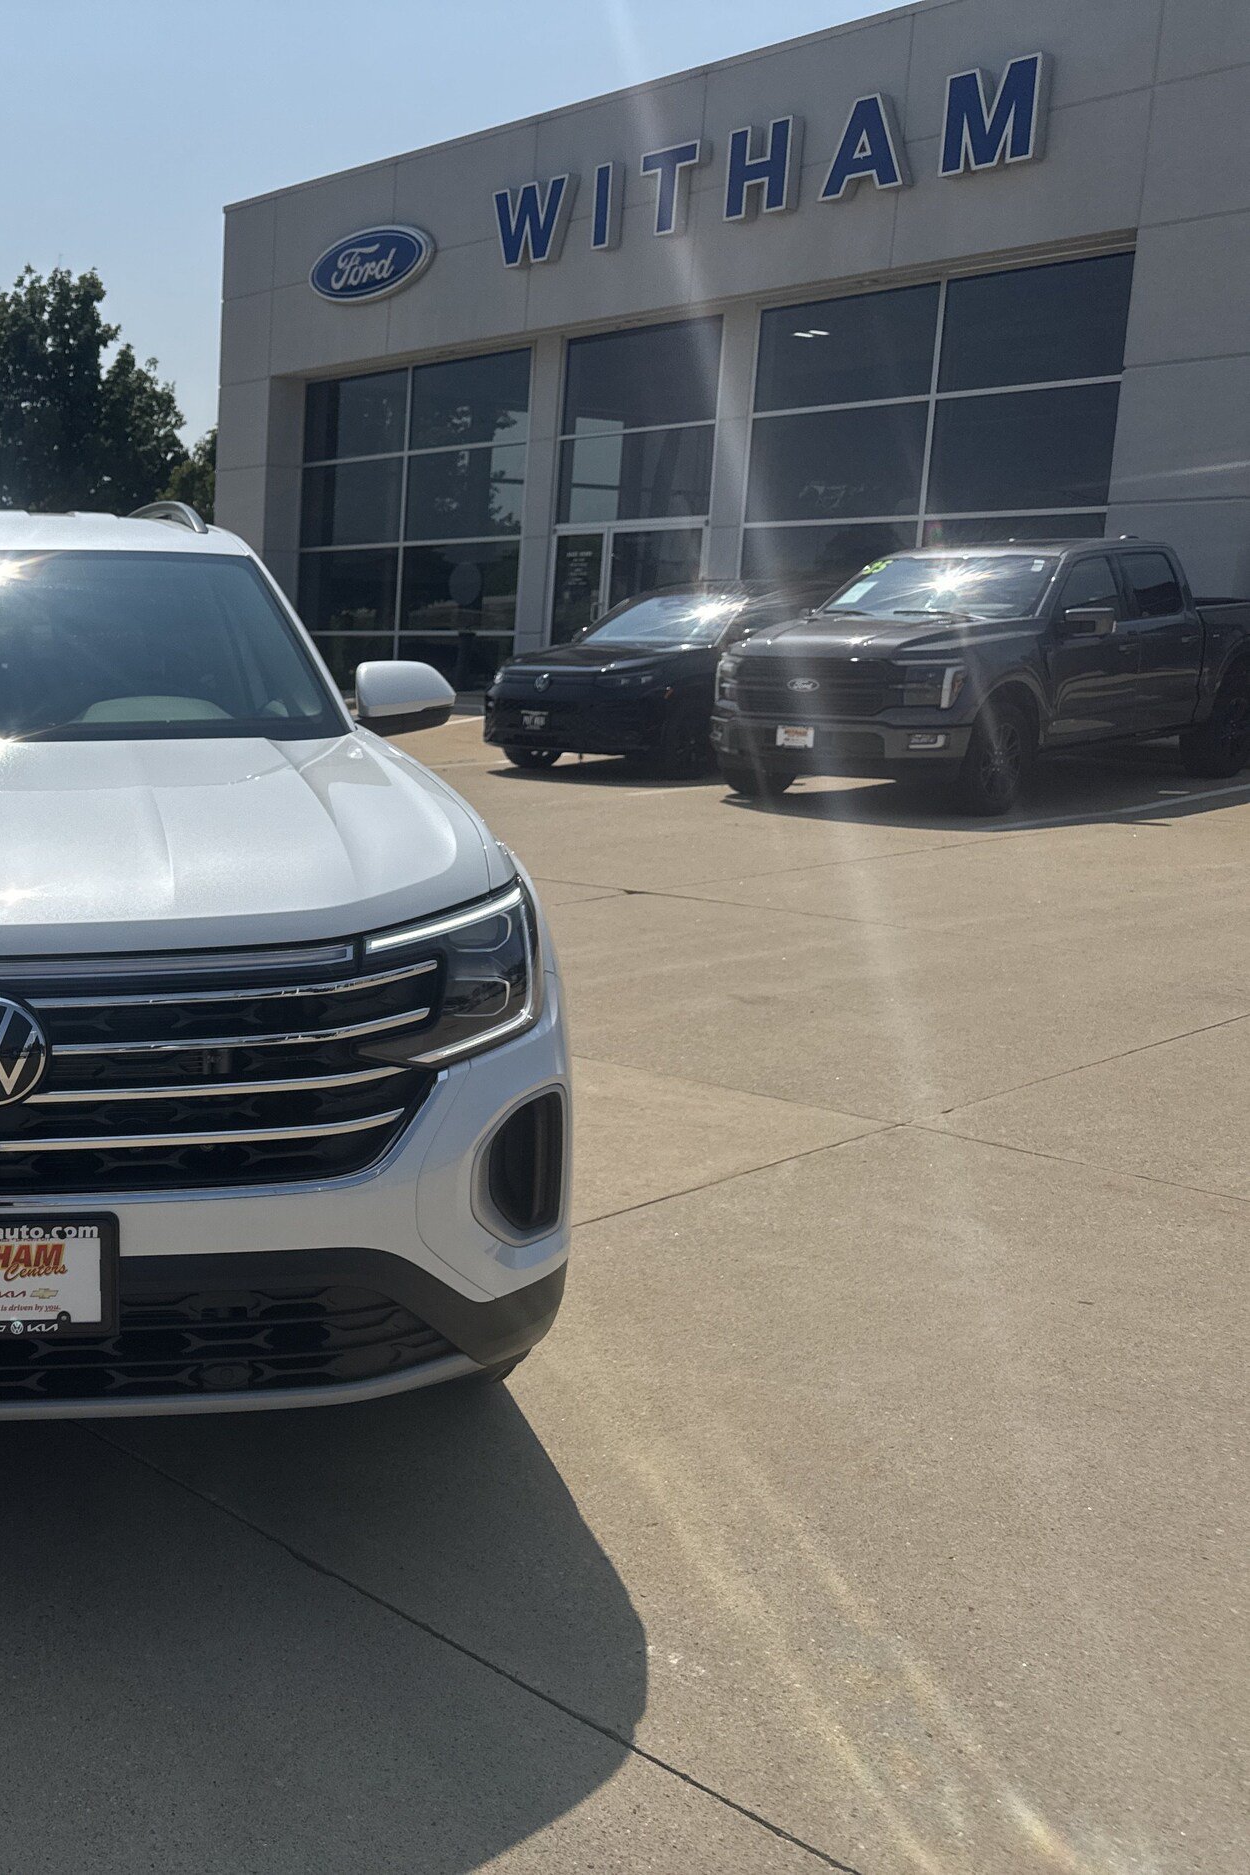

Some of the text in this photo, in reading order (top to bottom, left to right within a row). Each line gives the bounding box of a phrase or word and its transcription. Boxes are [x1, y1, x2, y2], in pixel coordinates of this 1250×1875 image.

[492, 51, 1044, 269] WITHAM
[330, 243, 397, 290] Ford
[4, 1263, 68, 1282] Centers
[34, 1304, 44, 1312] by
